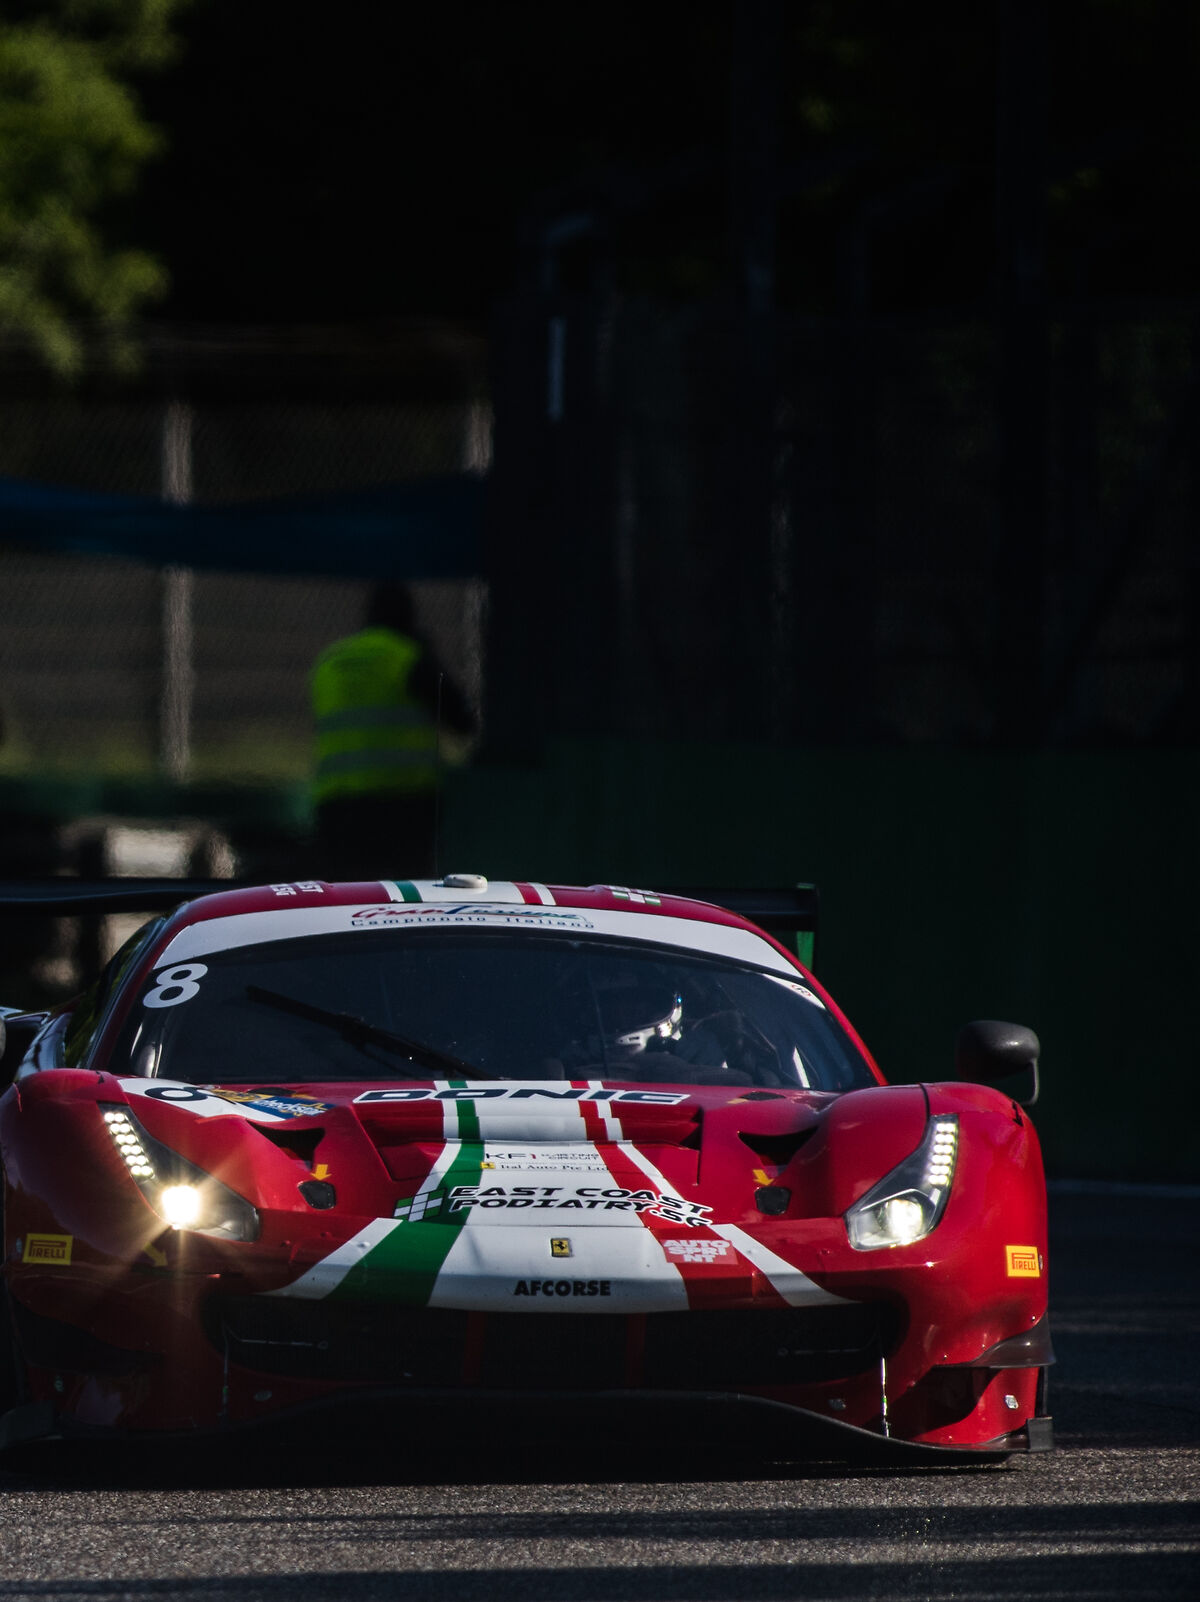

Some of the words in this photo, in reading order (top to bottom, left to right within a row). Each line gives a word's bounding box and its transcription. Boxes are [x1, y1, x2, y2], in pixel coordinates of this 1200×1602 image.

[351, 915, 484, 926] Campionato
[505, 917, 594, 929] Italiano
[142, 963, 208, 1008] 8
[353, 1088, 689, 1105] DONIC
[450, 1187, 563, 1198] EAST
[575, 1187, 714, 1214] COAST
[448, 1198, 714, 1227] PODIATRY.SG
[29, 1240, 67, 1259] PIRELLI
[663, 1239, 730, 1248] AUTO
[668, 1246, 727, 1255] SPRI
[684, 1254, 716, 1263] NT
[1011, 1252, 1037, 1271] PIRELLI
[514, 1280, 611, 1297] AFCORSE
